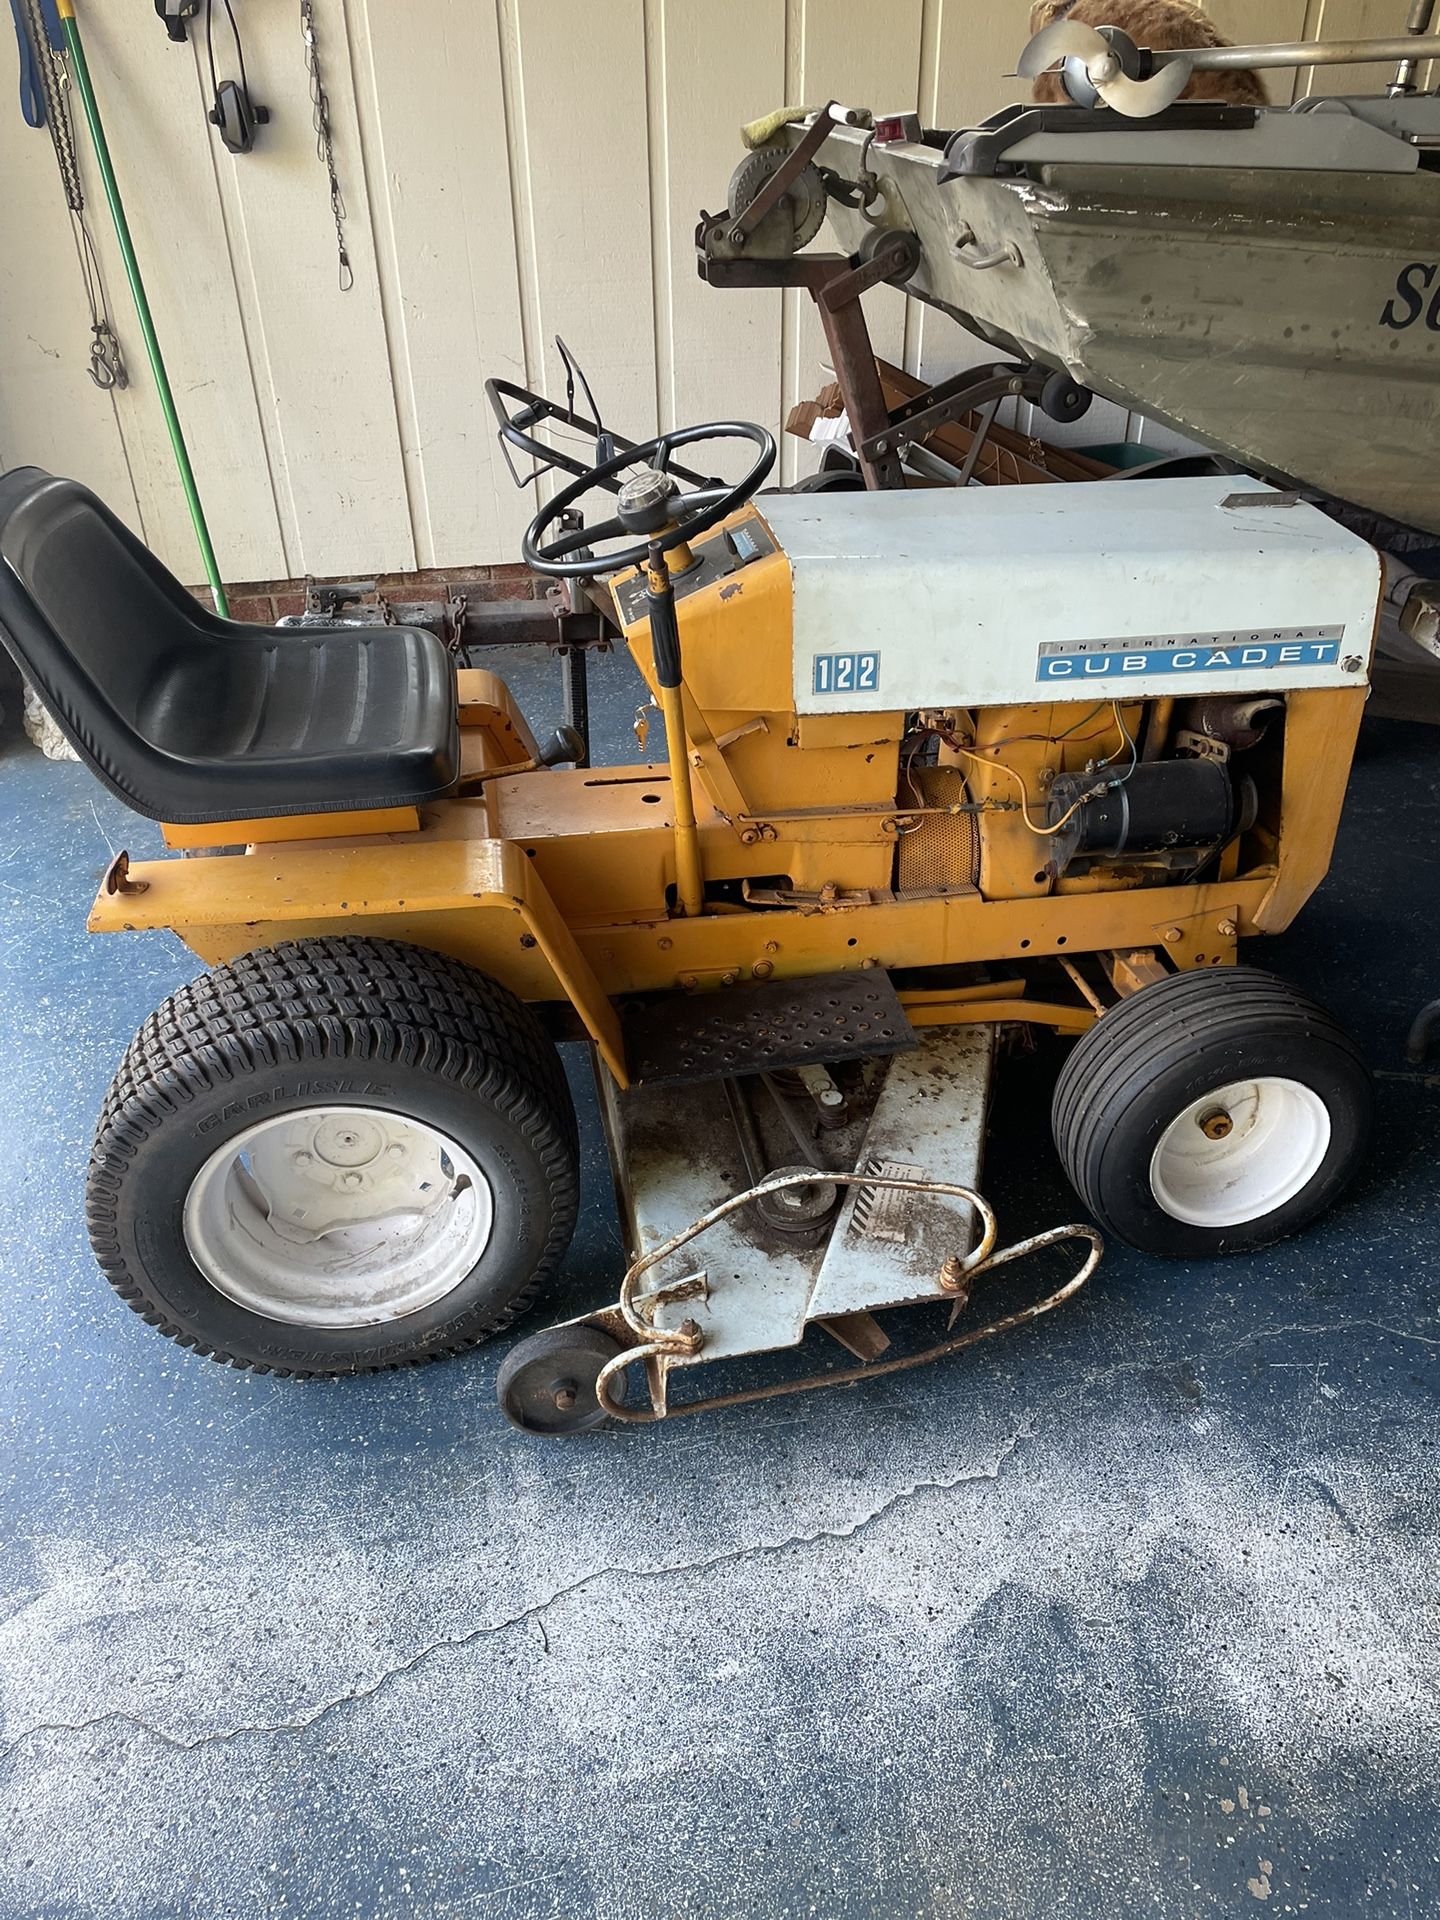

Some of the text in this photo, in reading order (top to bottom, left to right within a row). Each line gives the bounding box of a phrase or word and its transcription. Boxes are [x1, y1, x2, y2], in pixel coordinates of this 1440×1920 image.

[1060, 630, 1325, 652] INTERNATIONAL
[819, 656, 875, 689] 122
[1048, 644, 1334, 676] CUB CADET
[197, 1079, 394, 1134] CARLISLE
